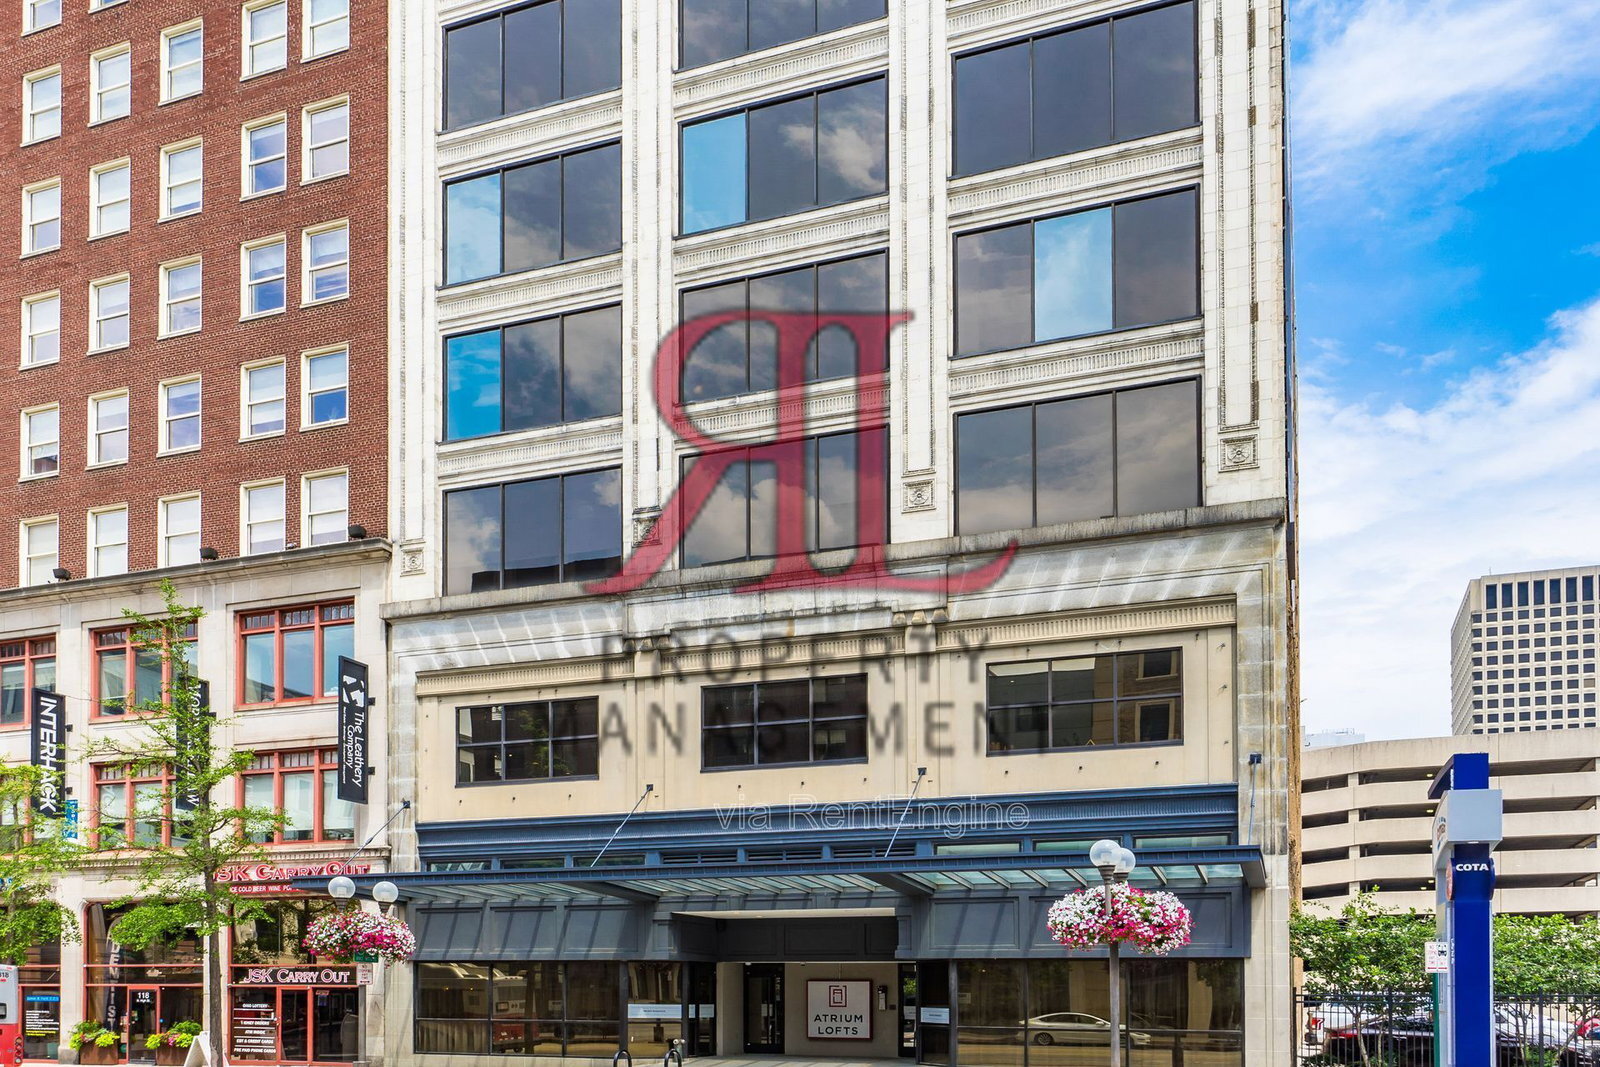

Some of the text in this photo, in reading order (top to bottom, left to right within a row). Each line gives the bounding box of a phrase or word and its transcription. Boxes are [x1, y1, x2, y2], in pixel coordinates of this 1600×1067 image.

[346, 724, 354, 768] Company
[352, 712, 364, 787] The Leathery
[40, 696, 57, 812] INTERHACK
[1455, 863, 1489, 871] COTA
[243, 969, 273, 983] JSK
[277, 969, 319, 983] CARRY
[320, 969, 350, 983] OUT
[814, 1014, 863, 1022] ATRIUM
[818, 1026, 858, 1035] LOFTS
